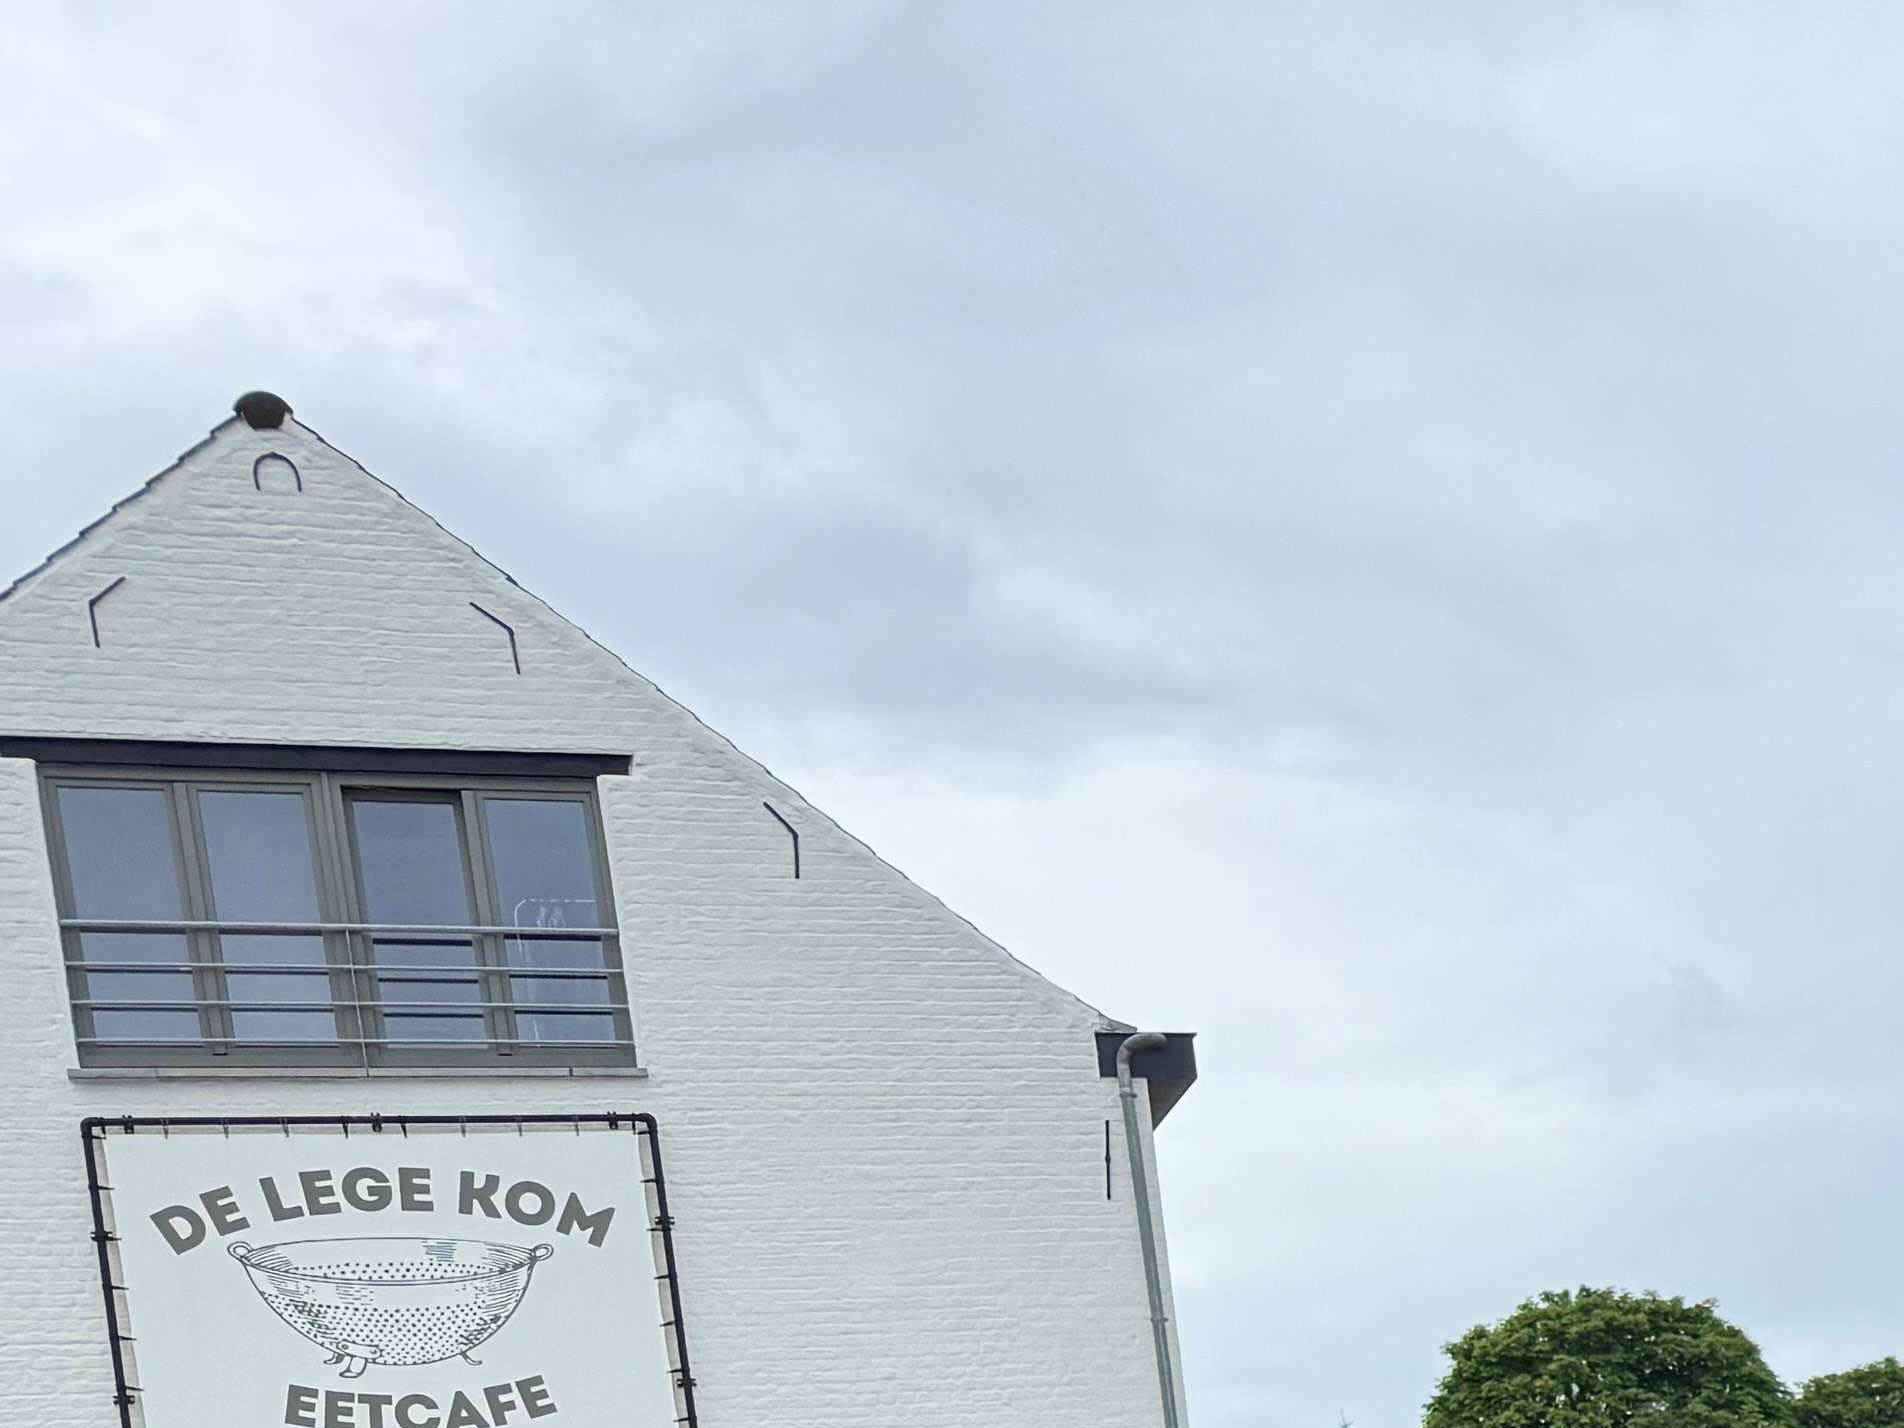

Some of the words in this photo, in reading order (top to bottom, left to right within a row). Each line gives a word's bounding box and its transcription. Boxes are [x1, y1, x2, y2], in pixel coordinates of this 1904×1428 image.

[150, 1185, 251, 1256] DE
[259, 1166, 435, 1223] LEGE
[458, 1170, 616, 1248] KOM
